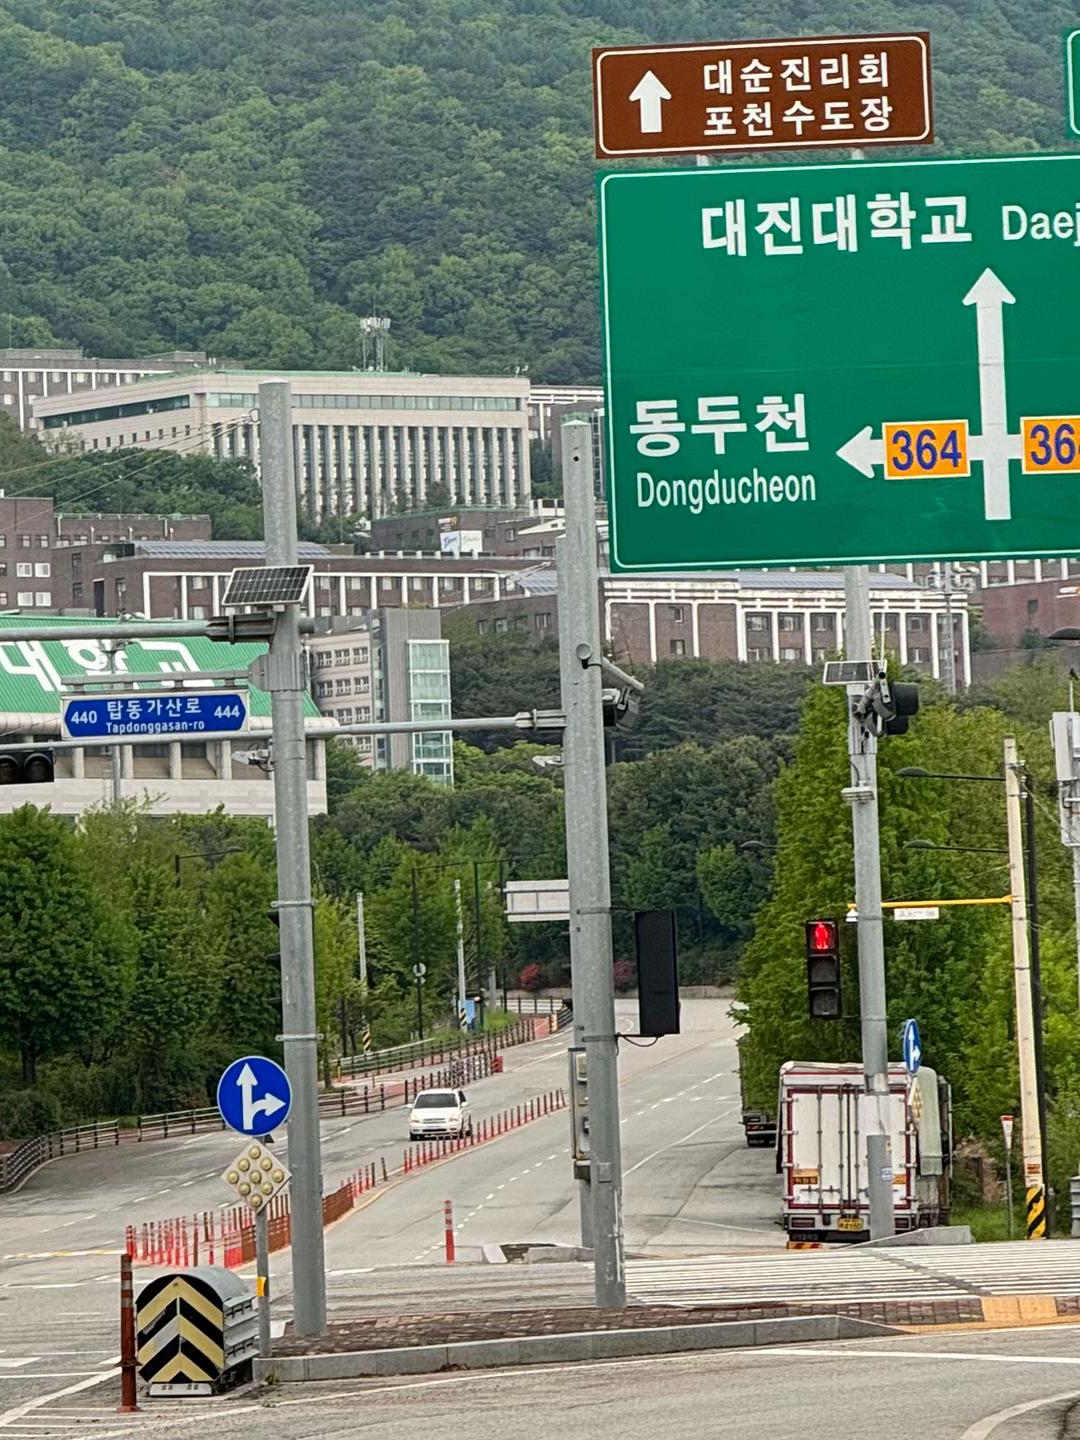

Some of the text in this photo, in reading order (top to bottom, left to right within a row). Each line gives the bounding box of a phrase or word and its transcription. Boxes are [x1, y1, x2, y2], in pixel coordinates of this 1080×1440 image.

[704, 52, 889, 94] 대순진리회
[704, 96, 893, 137] 포천수도장
[702, 192, 972, 256] 대진대학교
[630, 393, 810, 457] 동두천
[1029, 423, 1080, 466] 36
[891, 428, 962, 471] 364
[636, 468, 817, 514] Dongducheon
[70, 698, 240, 724] 440 탑동가산로 444
[105, 720, 205, 734] Tapdonggasan-ro
